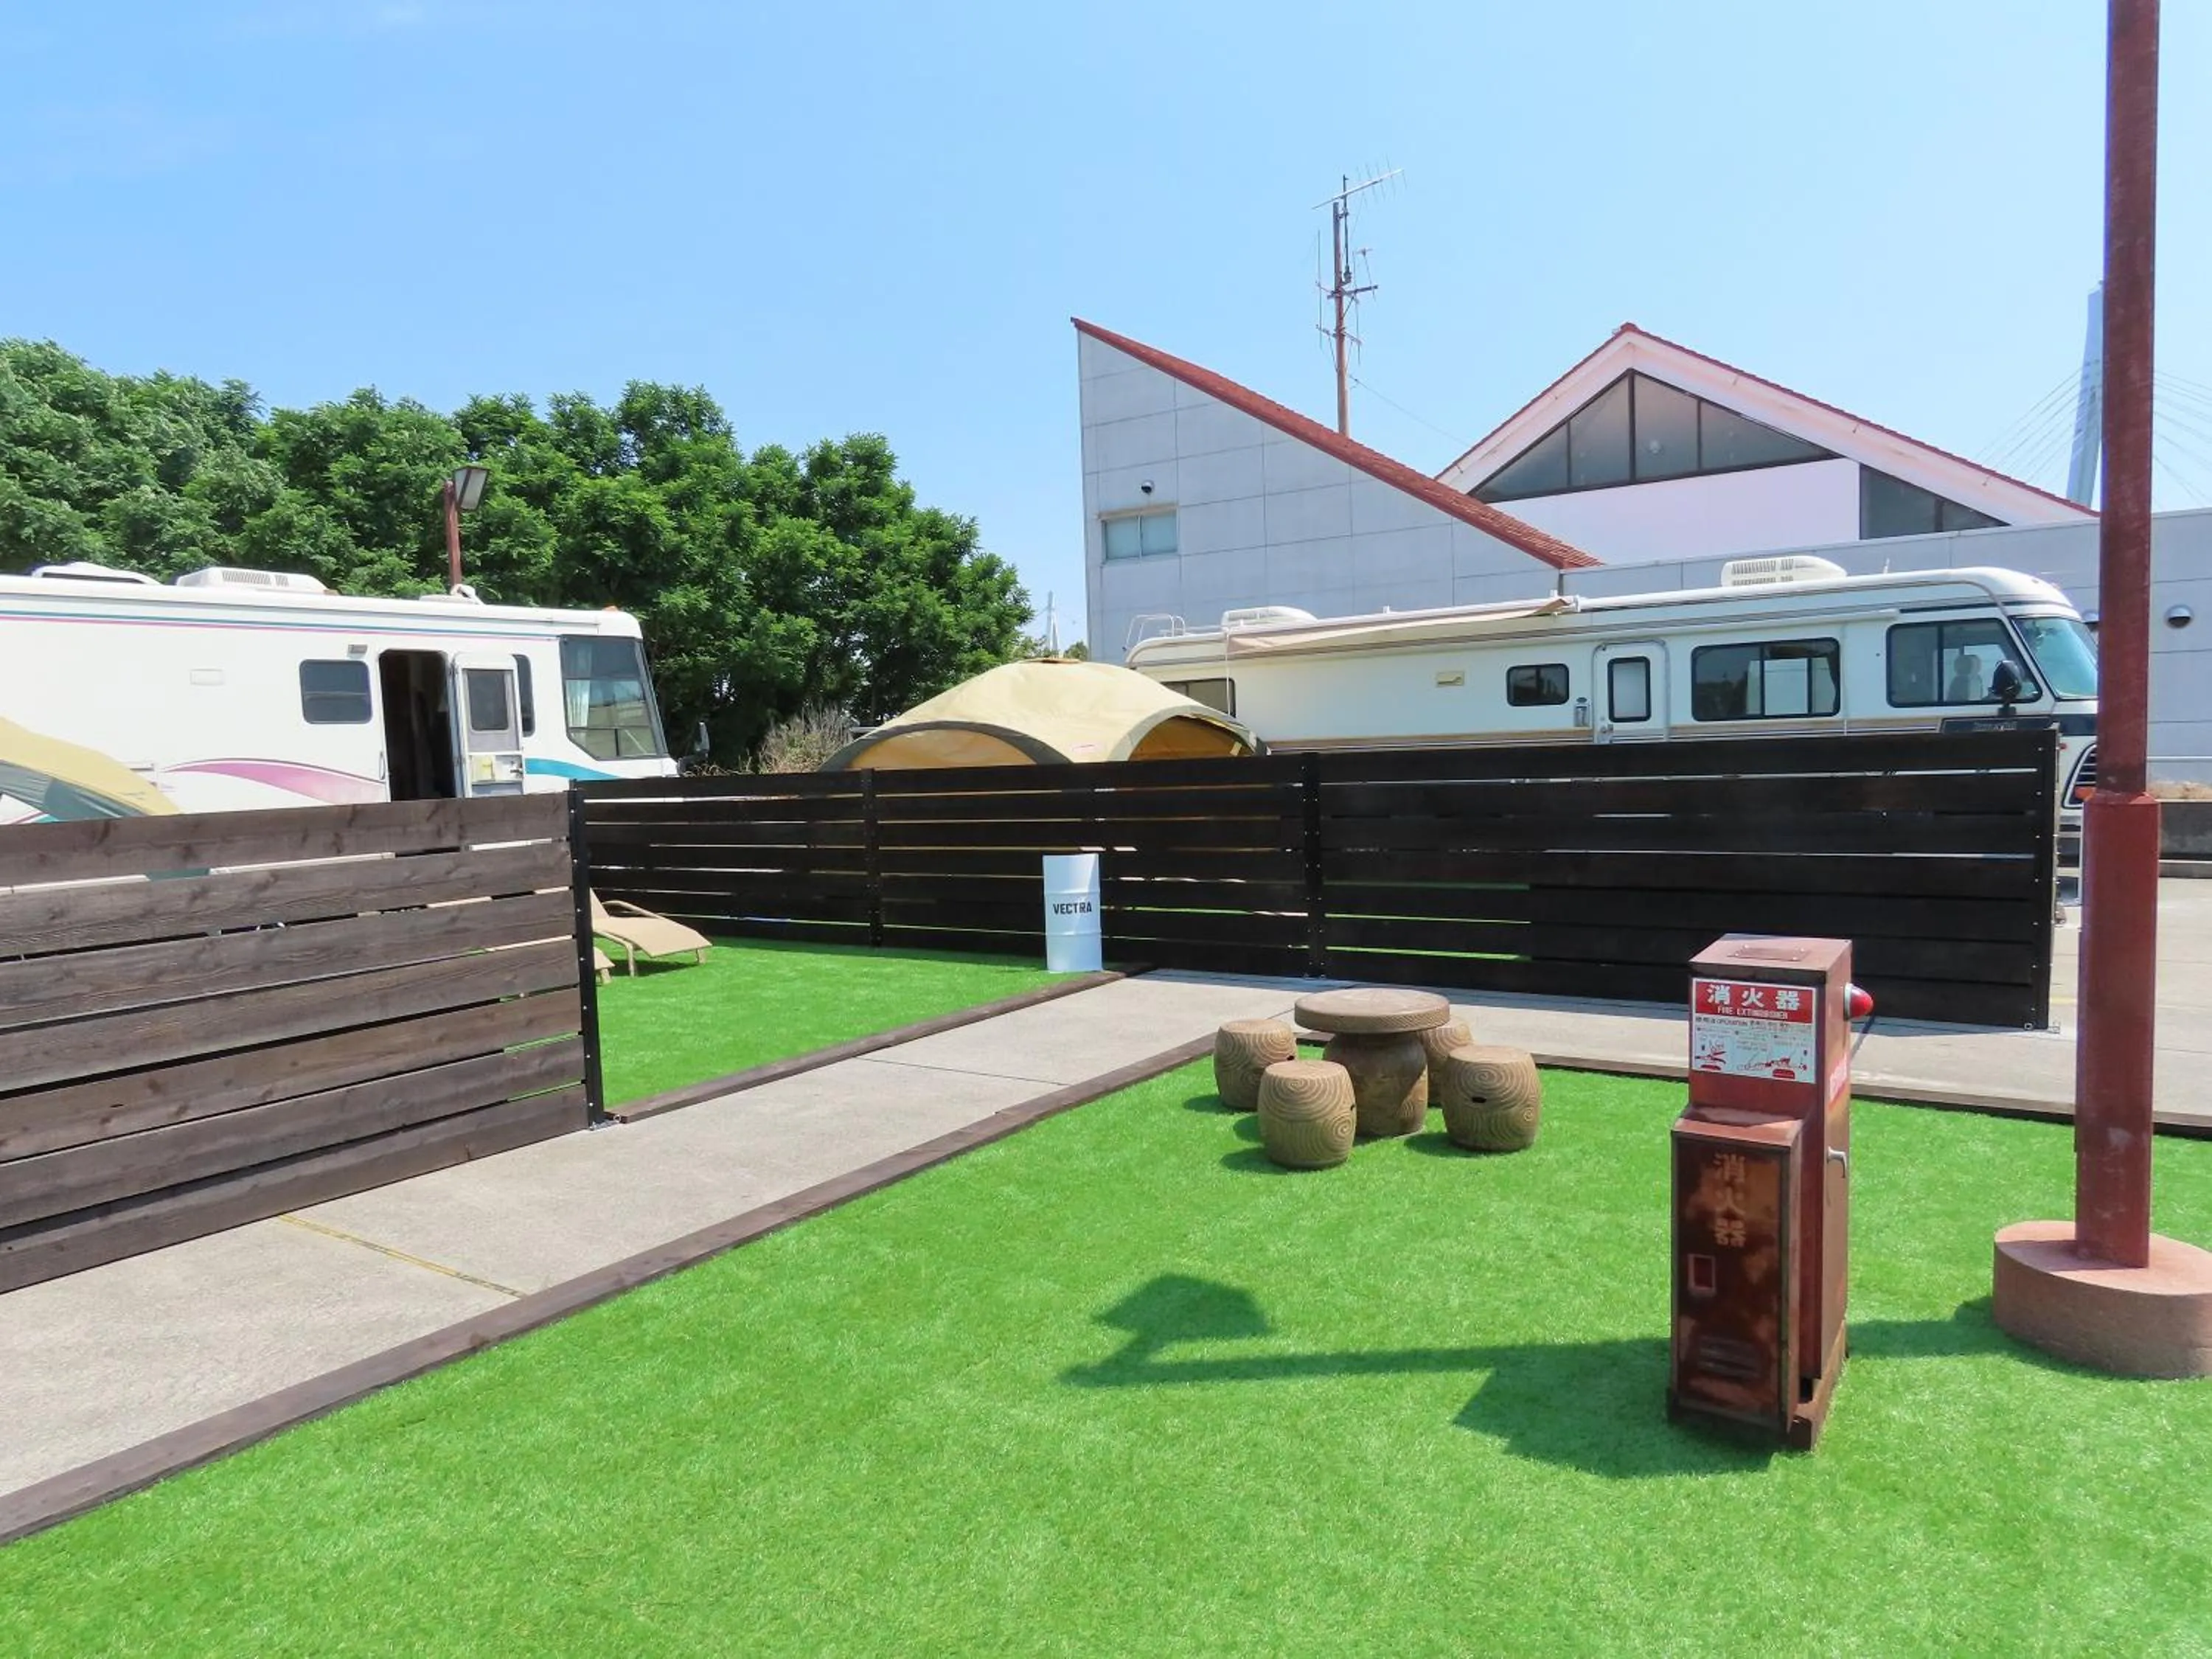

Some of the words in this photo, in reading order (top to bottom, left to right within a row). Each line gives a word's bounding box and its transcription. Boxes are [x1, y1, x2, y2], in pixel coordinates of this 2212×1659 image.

[1052, 901, 1092, 914] VECTRA
[1706, 984, 1800, 1011] 消火器
[1714, 1152, 1746, 1248] 消火器
